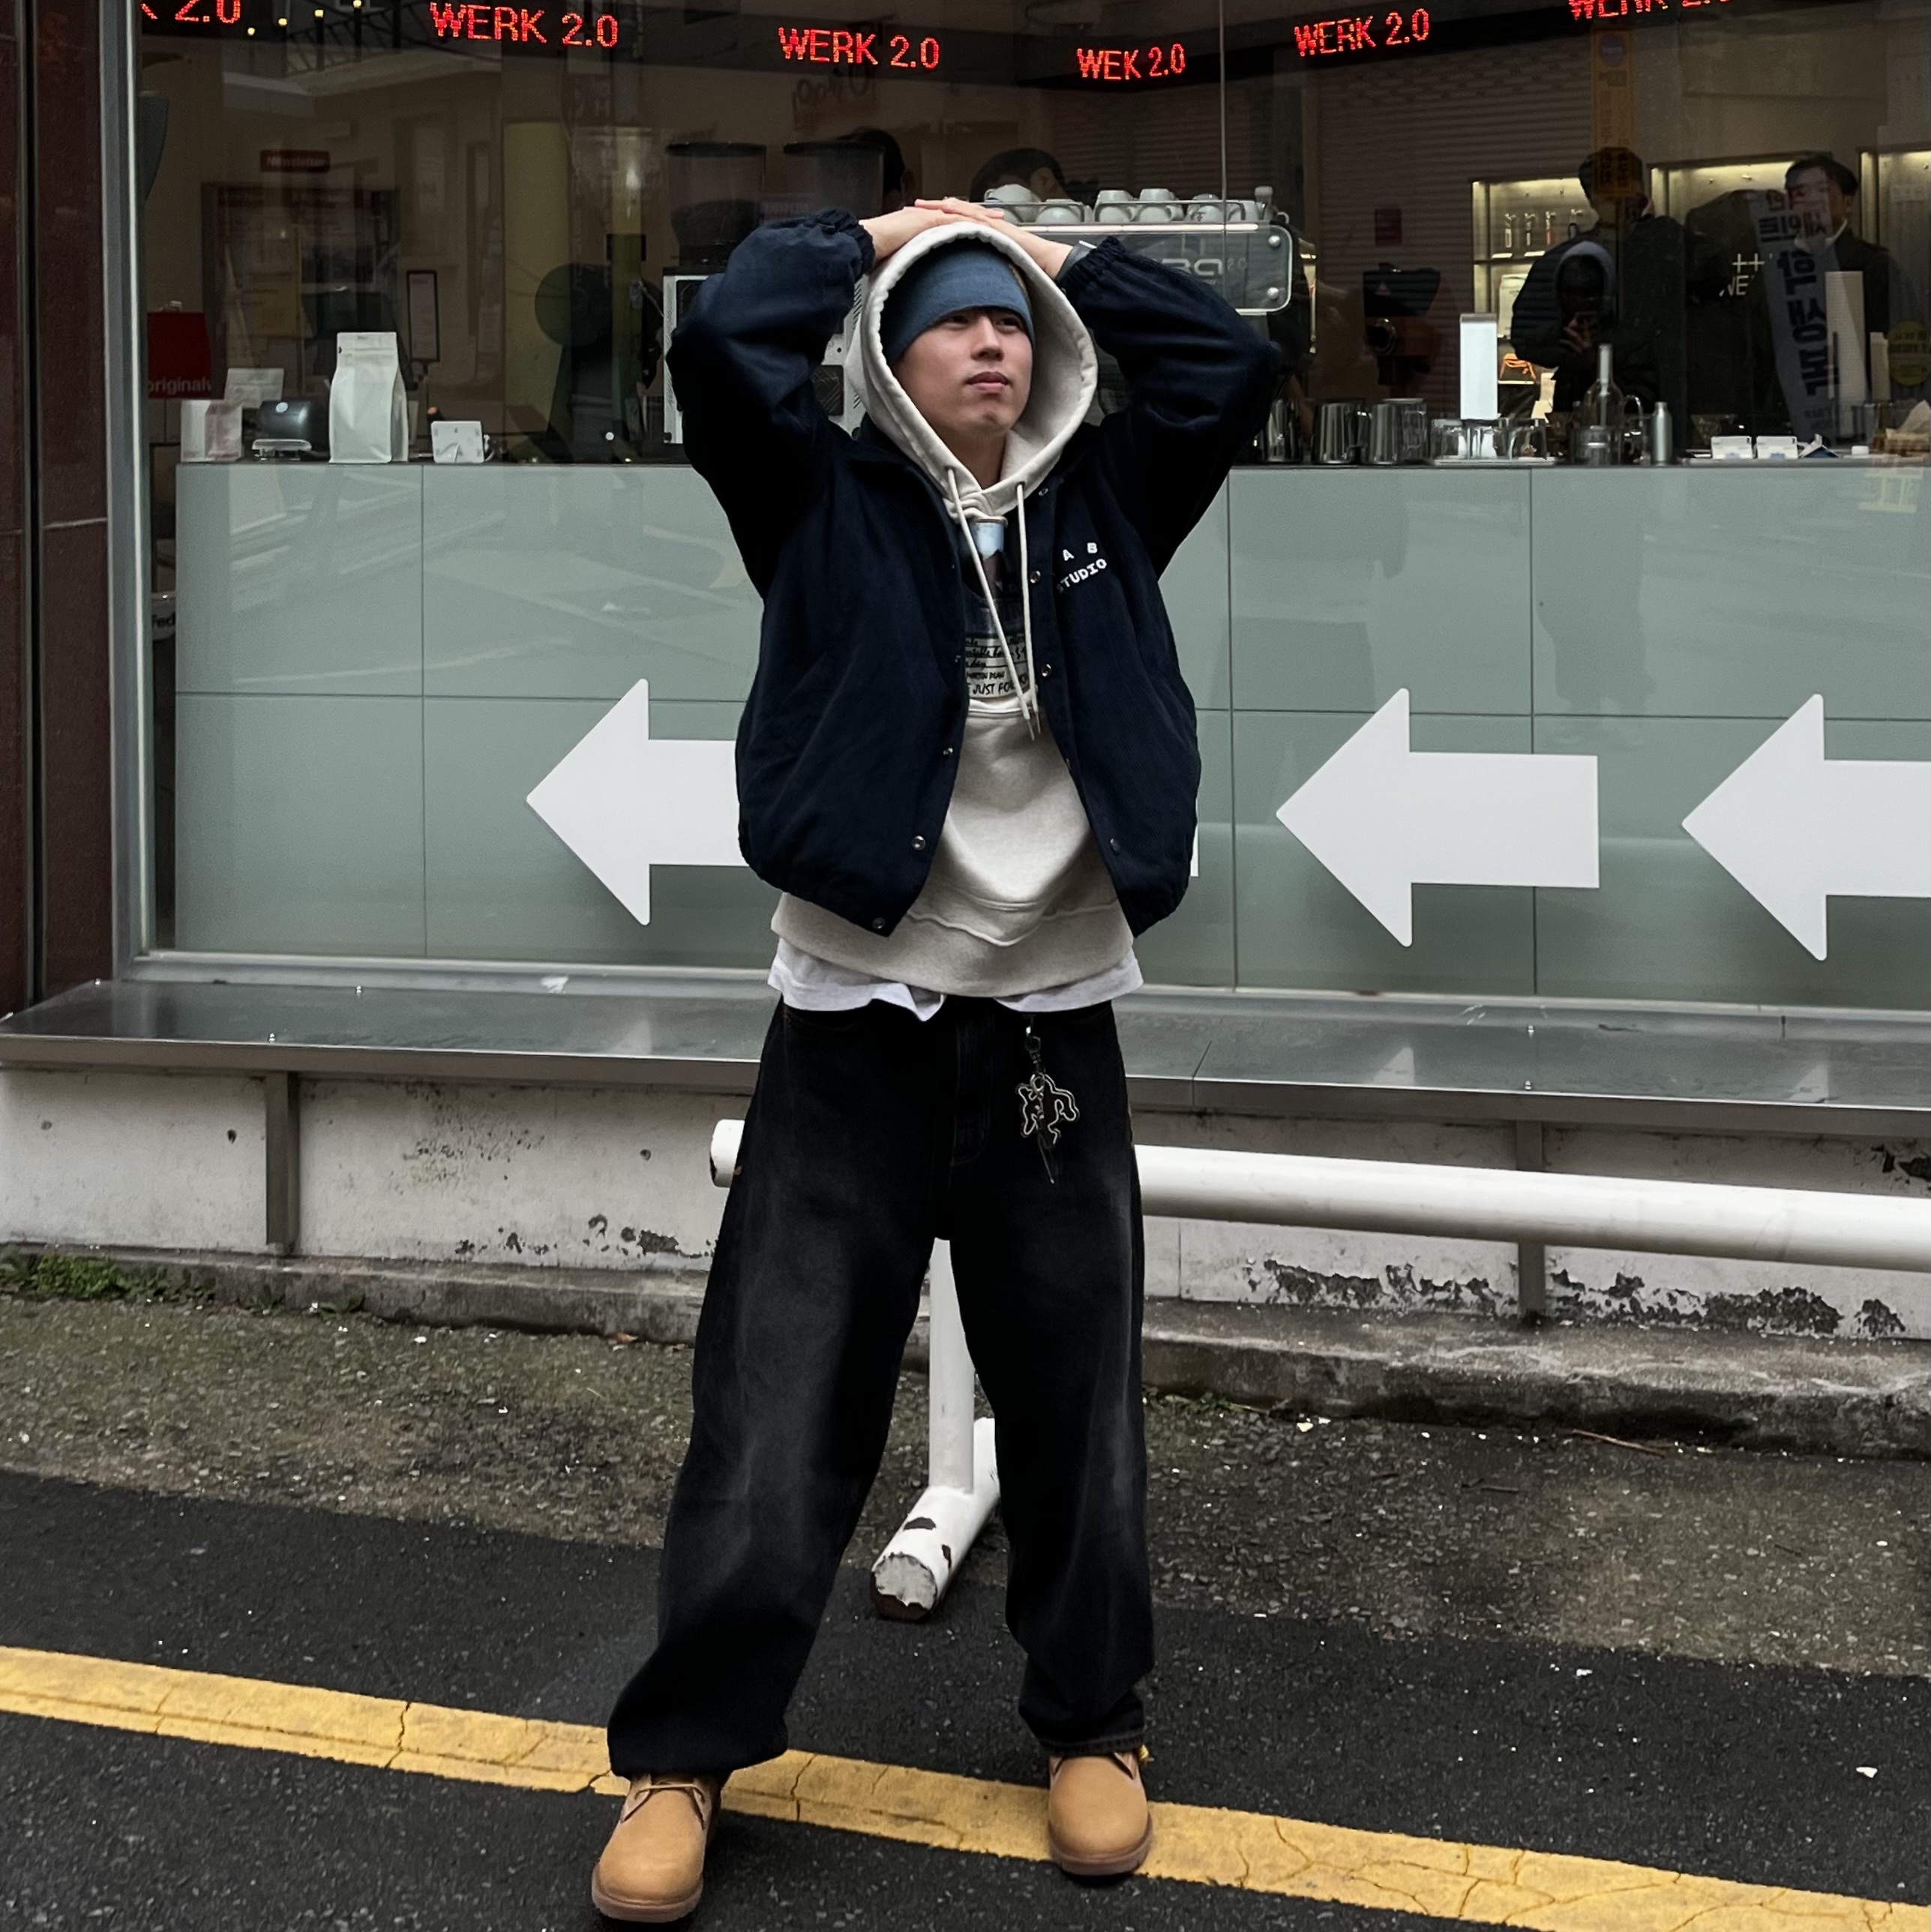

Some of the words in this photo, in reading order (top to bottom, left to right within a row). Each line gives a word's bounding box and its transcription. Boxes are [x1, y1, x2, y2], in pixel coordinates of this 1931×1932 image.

[430, 2, 547, 43] WERK
[562, 13, 619, 46] 2.0
[1294, 16, 1377, 57] WERK
[1386, 8, 1430, 45] 2.0
[778, 27, 878, 64] WERK
[890, 35, 940, 69] 2.0
[1077, 48, 1142, 80] WEK
[1148, 44, 1186, 76] 2.0
[973, 683, 996, 694] JUST
